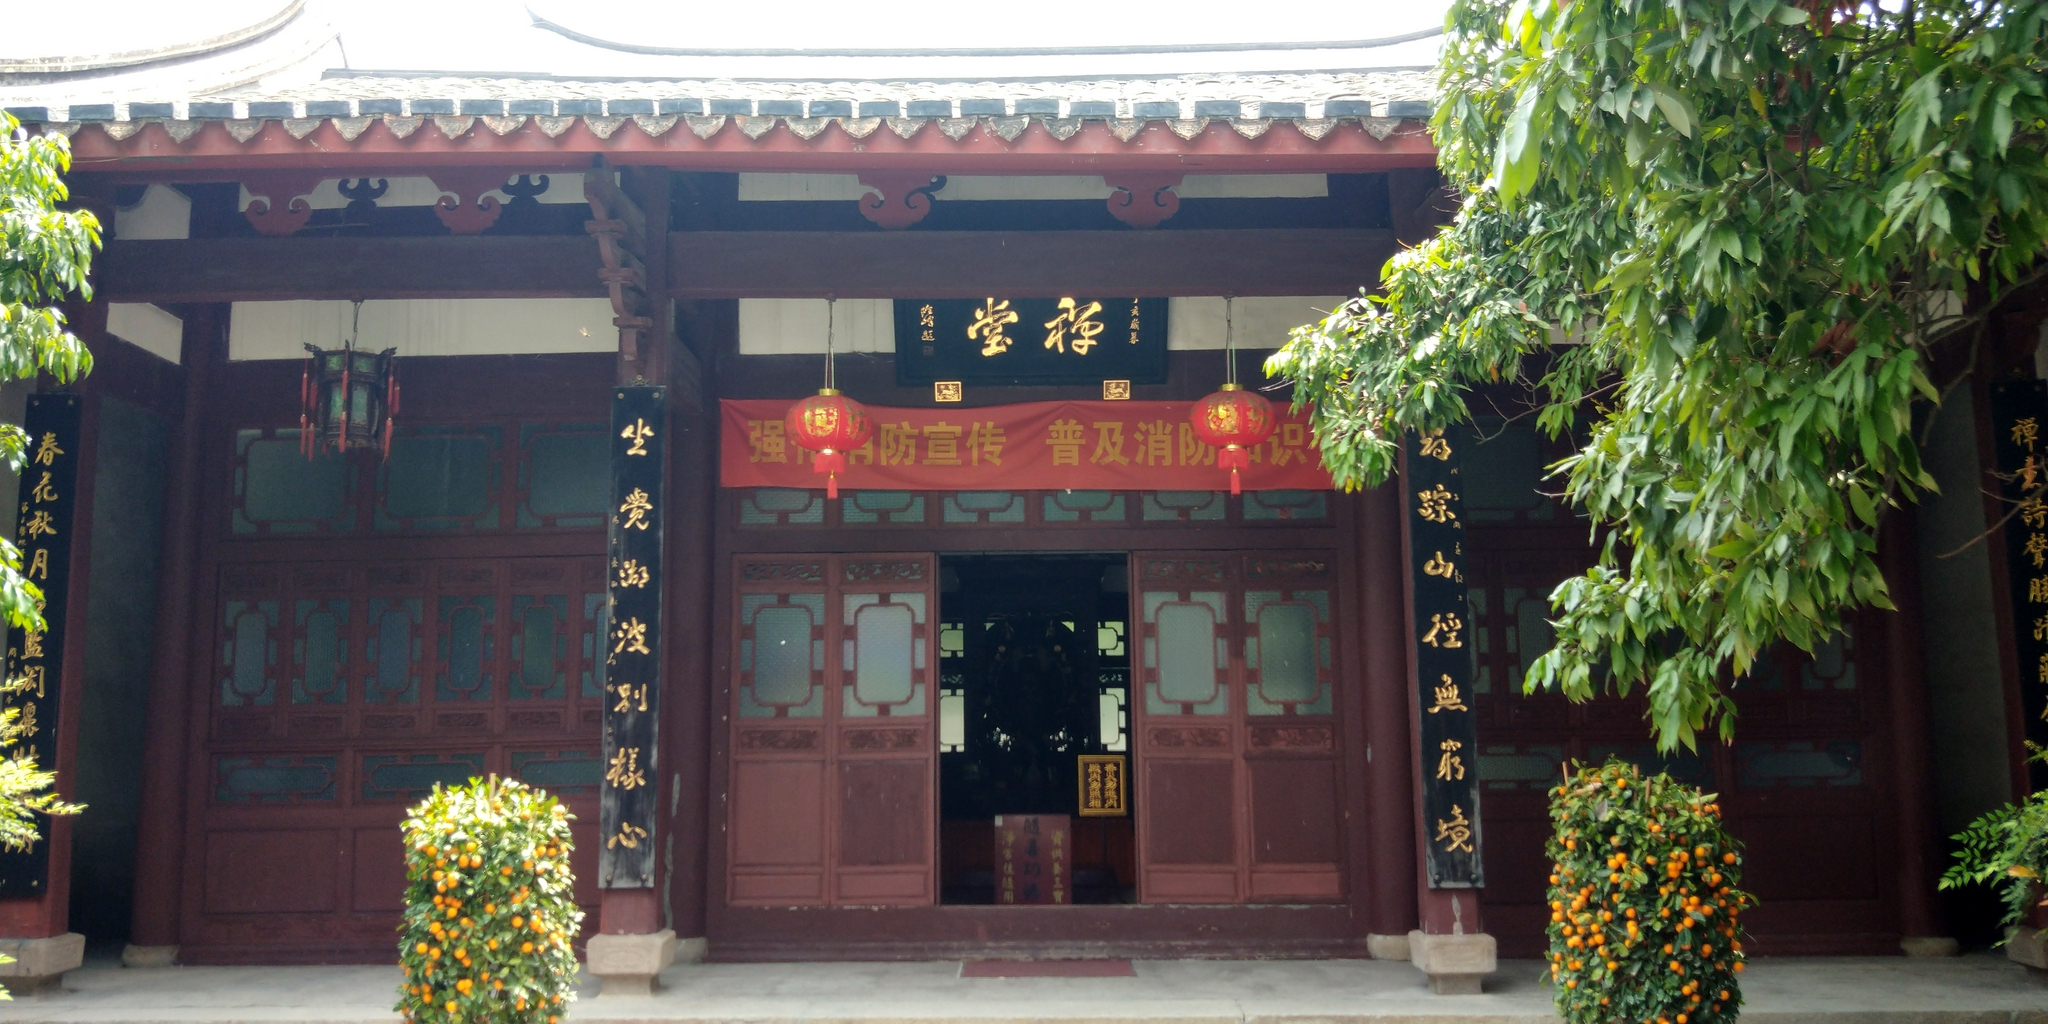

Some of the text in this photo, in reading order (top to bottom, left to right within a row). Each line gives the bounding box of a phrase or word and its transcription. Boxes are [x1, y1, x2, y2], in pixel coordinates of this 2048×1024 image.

[748, 420, 1007, 467] 强防宣传
[1046, 418, 1308, 467] 普及消防识
